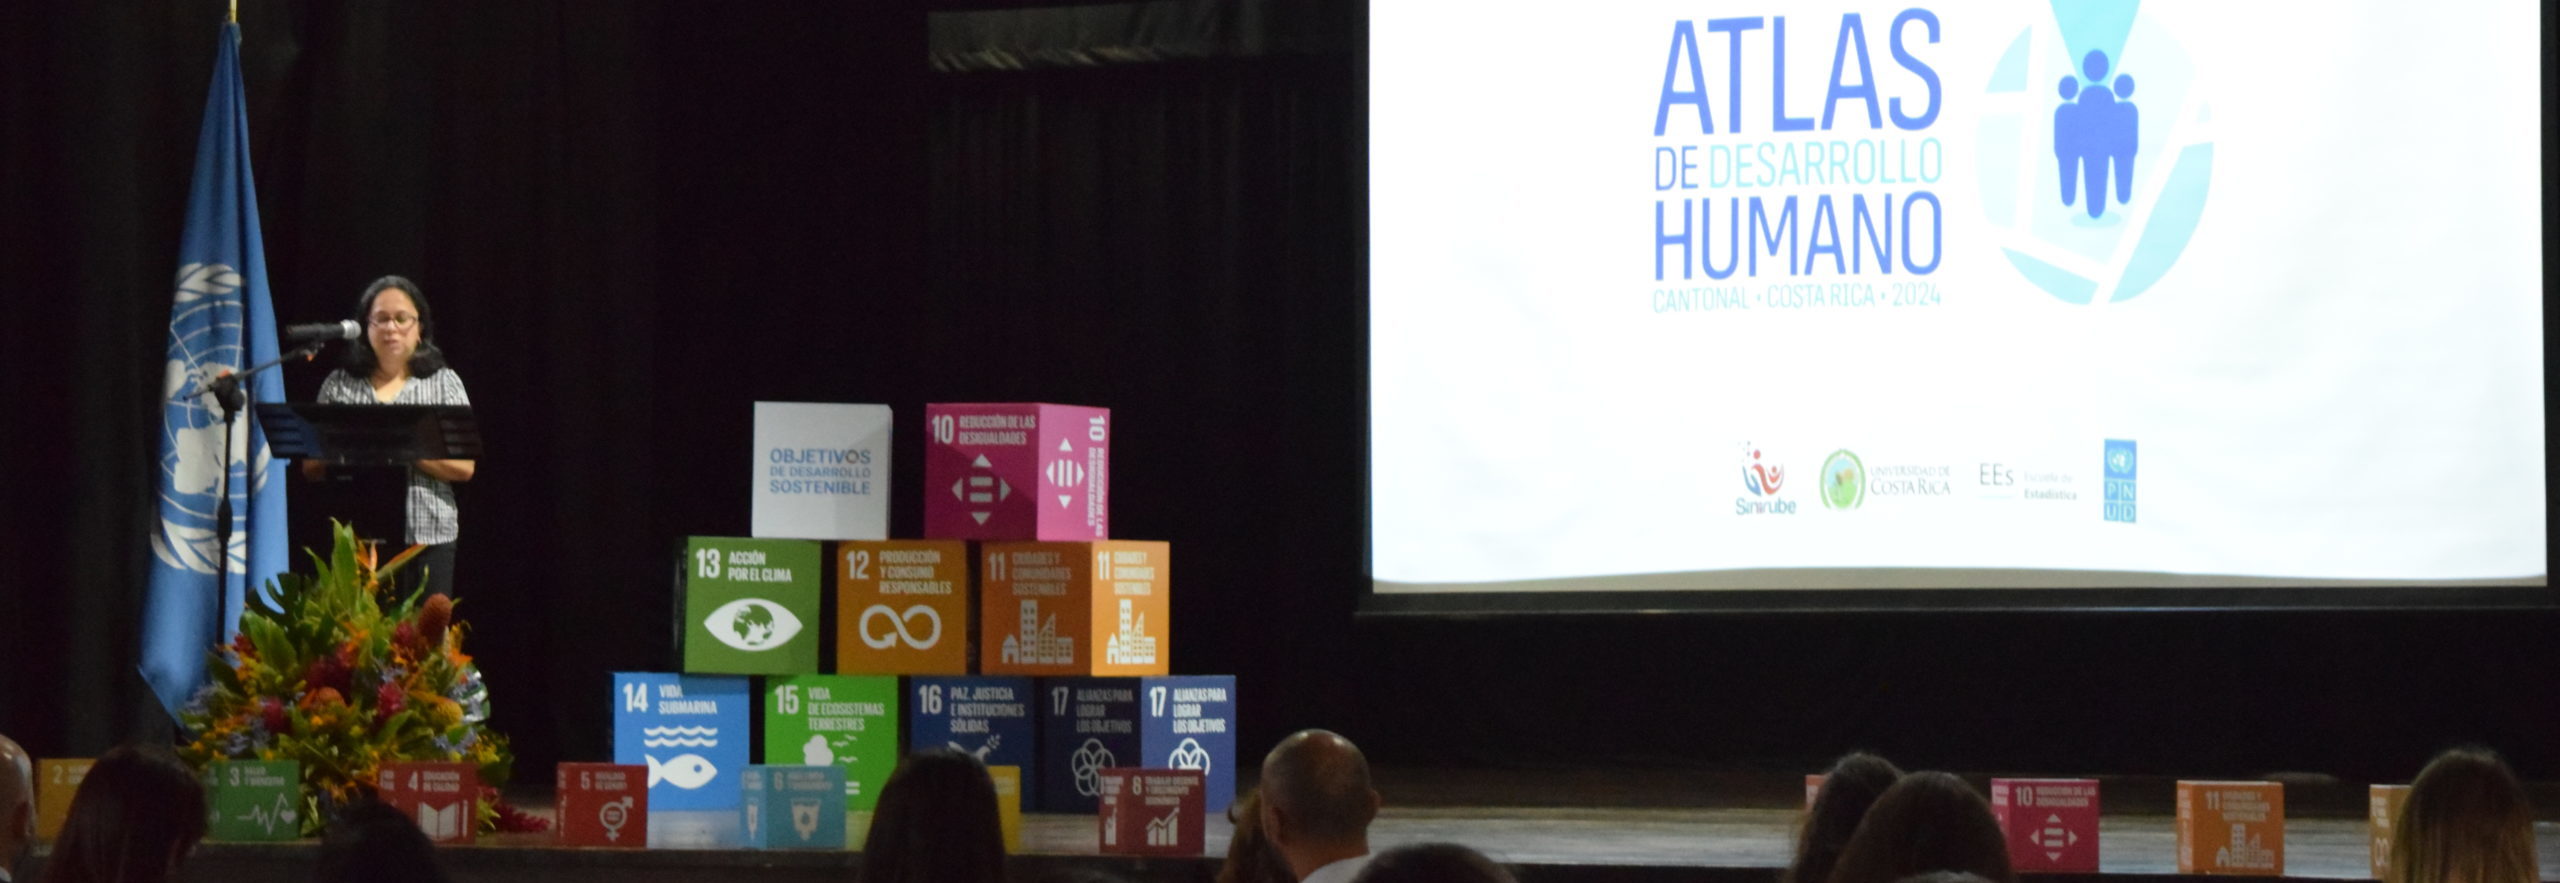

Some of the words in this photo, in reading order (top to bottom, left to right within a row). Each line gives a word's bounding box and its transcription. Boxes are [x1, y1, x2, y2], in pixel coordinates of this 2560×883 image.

[1653, 7, 1942, 136] ATLAS
[1656, 145, 1698, 191] DE
[1709, 138, 1942, 188] DESARROLLO
[1655, 191, 1942, 281] HUMANO
[1652, 287, 1749, 314] CANTONAL
[1767, 284, 1825, 309] COSTA
[1830, 283, 1874, 307] RICA
[1892, 282, 1941, 307] 2024
[932, 414, 954, 445] 10
[1019, 414, 1036, 429] LAS
[1089, 415, 1105, 441] 10
[770, 448, 871, 465] OBJETIVOS
[770, 466, 787, 478] DE
[790, 467, 871, 479] DESARROLLO
[1870, 466, 1936, 477] UNIVERSIDAD
[1939, 465, 1950, 477] DE
[770, 480, 871, 495] SOSTENIBLE
[1870, 479, 1914, 496] COSTA
[1917, 478, 1951, 496] RICA
[696, 548, 720, 579] 13
[728, 550, 766, 565] ACCIÓN
[846, 550, 869, 580] 12
[879, 549, 941, 564] PRODUCCIÓN
[988, 552, 1005, 581] 11
[1097, 550, 1110, 581] 11
[728, 568, 749, 581] POR
[750, 568, 761, 581] EL
[762, 568, 792, 583] CLIMA
[880, 567, 886, 579] Y
[888, 567, 934, 579] CONSUMO
[879, 581, 952, 594] RESPONSABLES
[623, 683, 648, 713] 14
[659, 684, 683, 699] VIDA
[774, 685, 799, 715] 15
[808, 687, 831, 701] VIDA
[919, 685, 942, 715] 16
[972, 687, 1014, 701] JUSTICIA
[1149, 686, 1167, 717] 17
[658, 701, 717, 715] SUBMARINA
[808, 703, 820, 716] DE
[821, 703, 884, 716] ECOSISTEMAS
[950, 704, 956, 716] E
[957, 704, 1025, 717] INSTITUCIONES
[1051, 687, 1069, 717] 17
[808, 718, 865, 732] TERRESTRES
[950, 717, 989, 733] SÓLIDAS
[230, 767, 240, 787] 3
[408, 770, 418, 791] 4
[581, 770, 590, 791] 5
[1132, 775, 1142, 796] 8
[2015, 786, 2033, 807] 10
[2205, 791, 2219, 811] 11
